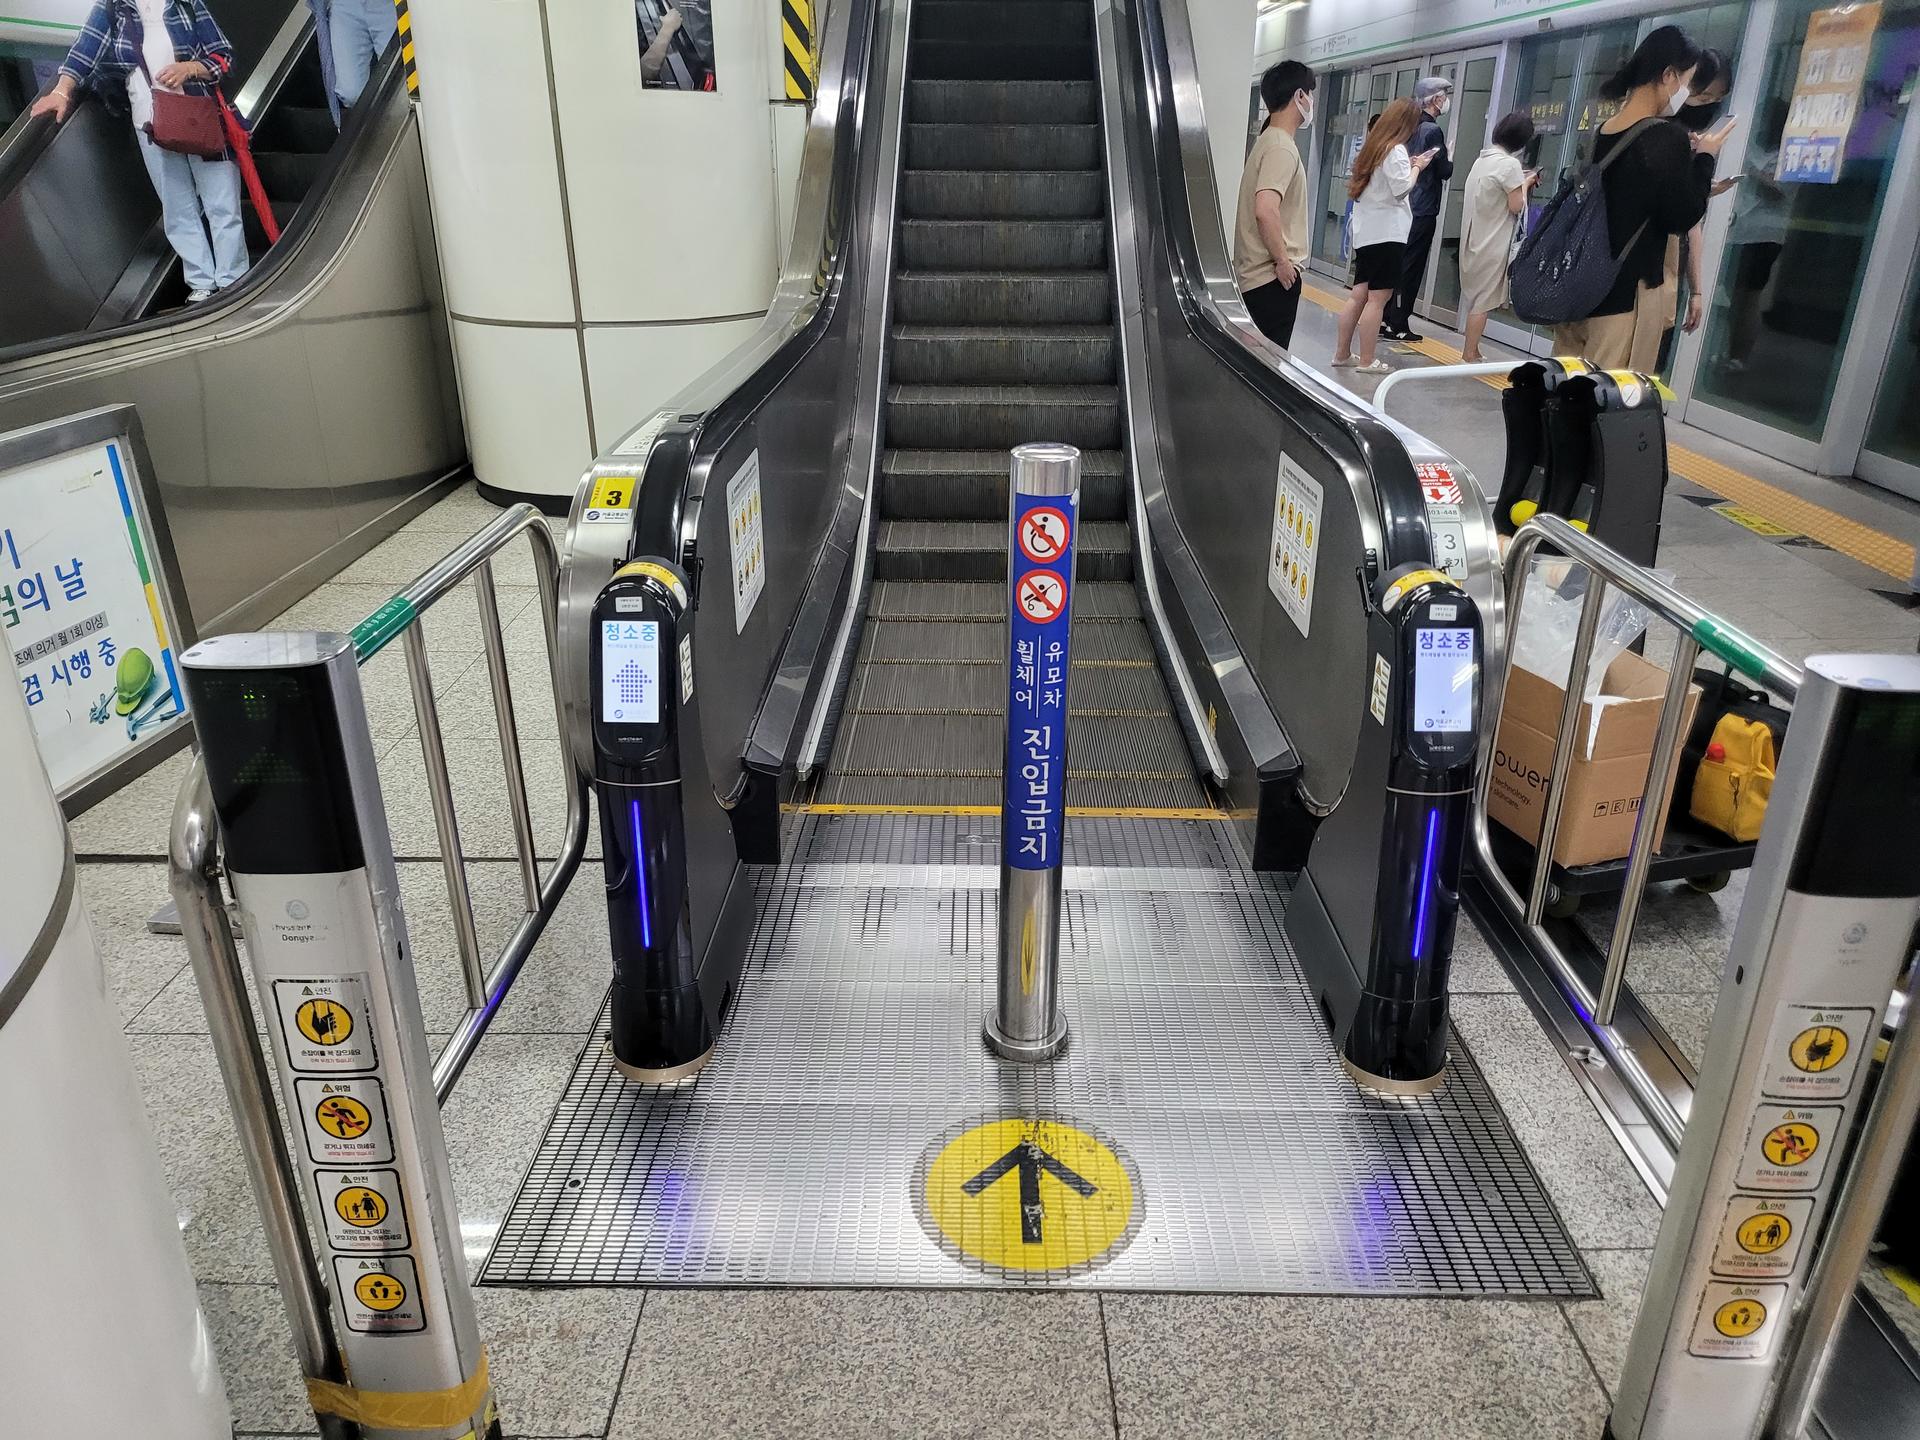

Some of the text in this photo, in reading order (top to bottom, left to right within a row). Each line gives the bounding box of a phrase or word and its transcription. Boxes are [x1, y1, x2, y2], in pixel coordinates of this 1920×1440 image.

[606, 490, 622, 506] 3
[1443, 534, 1456, 550] 3
[1444, 557, 1464, 568] 호기
[54, 557, 88, 602] 날
[57, 631, 69, 646] 월
[86, 615, 104, 632] 이상
[22, 637, 117, 707] 검 시행 중
[1016, 639, 1034, 711] 휠체어
[1043, 641, 1064, 709] 유모차
[1019, 726, 1052, 863] 진입금지
[335, 1084, 351, 1093] 위험
[353, 1175, 369, 1184] 안전
